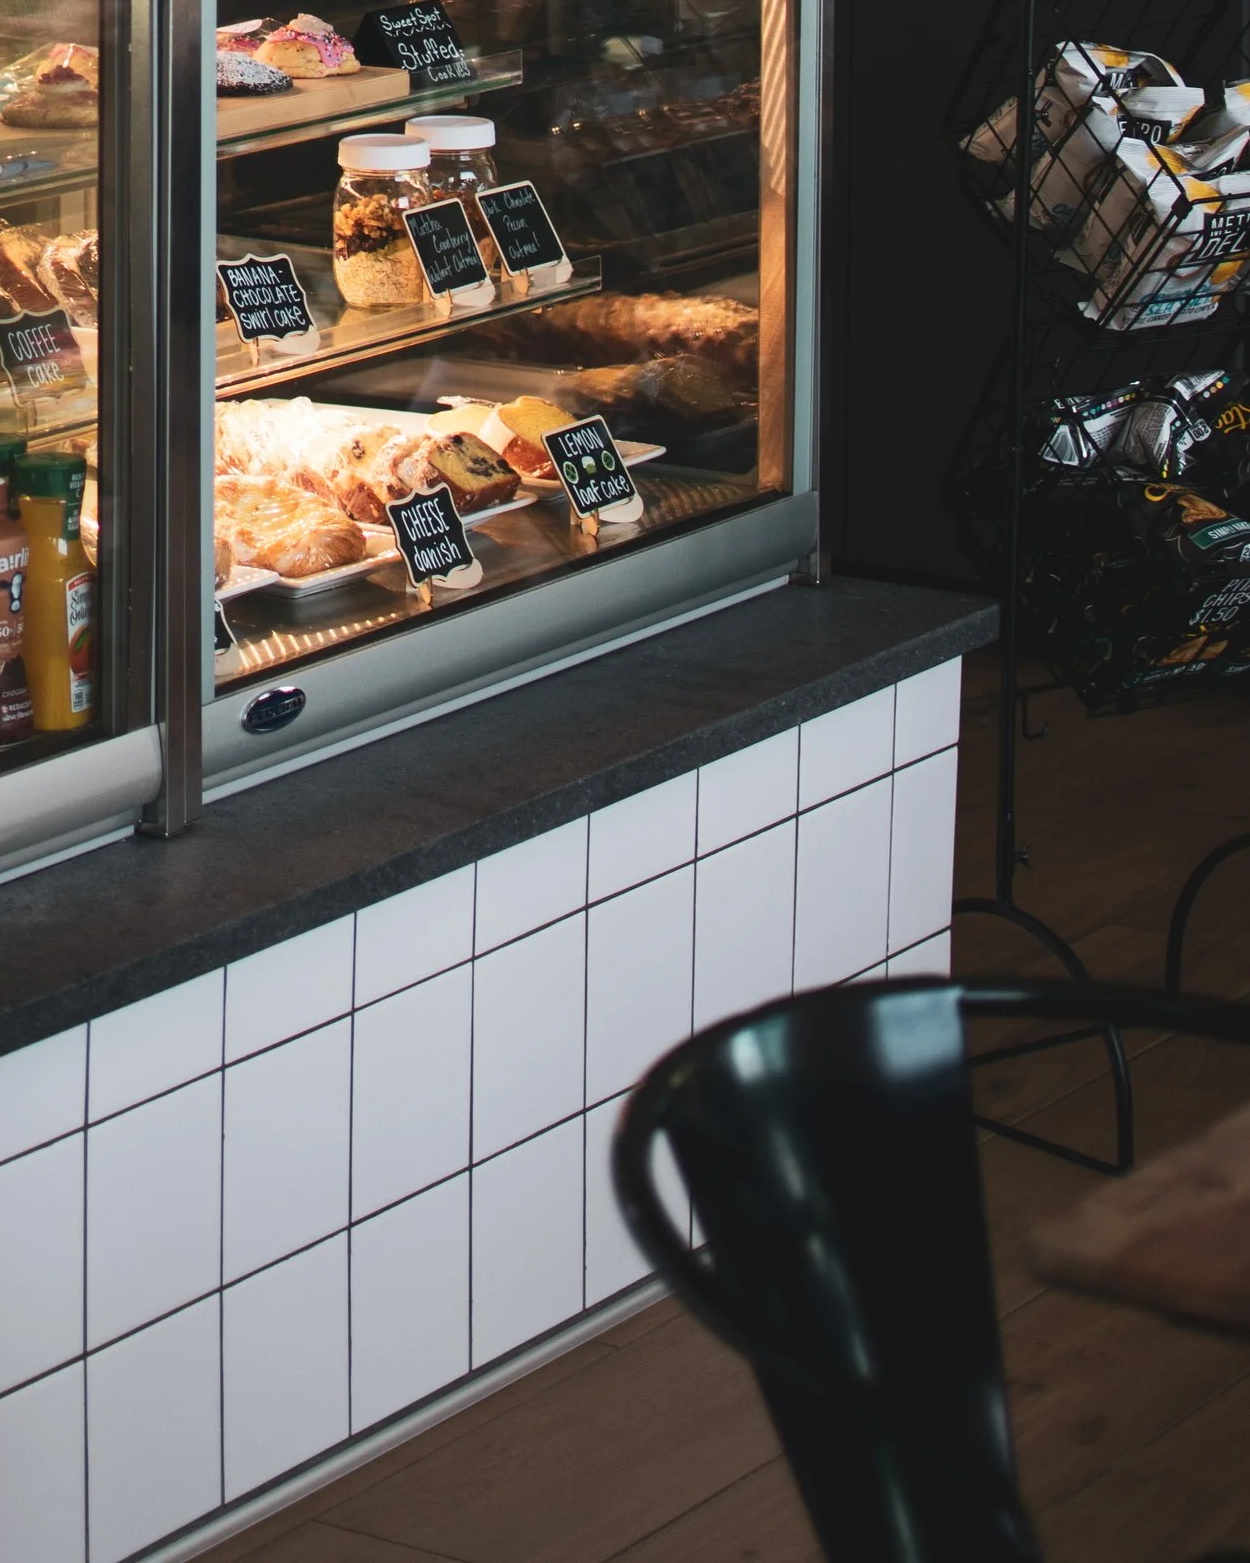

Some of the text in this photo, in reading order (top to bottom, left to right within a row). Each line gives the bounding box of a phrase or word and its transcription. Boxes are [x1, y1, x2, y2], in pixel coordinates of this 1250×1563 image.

[379, 7, 442, 31] Sweet Spot
[398, 36, 460, 70] Stuffed
[481, 187, 536, 219] Dark Chocolate
[408, 212, 443, 238] Matcha
[502, 215, 529, 233] Pecan
[432, 227, 472, 253] Cranberry
[1198, 231, 1248, 259] DEL
[427, 255, 453, 285] Walnut
[232, 284, 301, 308] CHOCOLATE
[273, 305, 306, 328] cake
[7, 324, 62, 362] COFFEE
[557, 425, 605, 458] LEMON
[600, 474, 630, 500] cake
[400, 497, 450, 543] CHEESE
[413, 535, 462, 573] danish
[1203, 591, 1250, 609] CHIPS
[1188, 605, 1240, 627] $1.50
